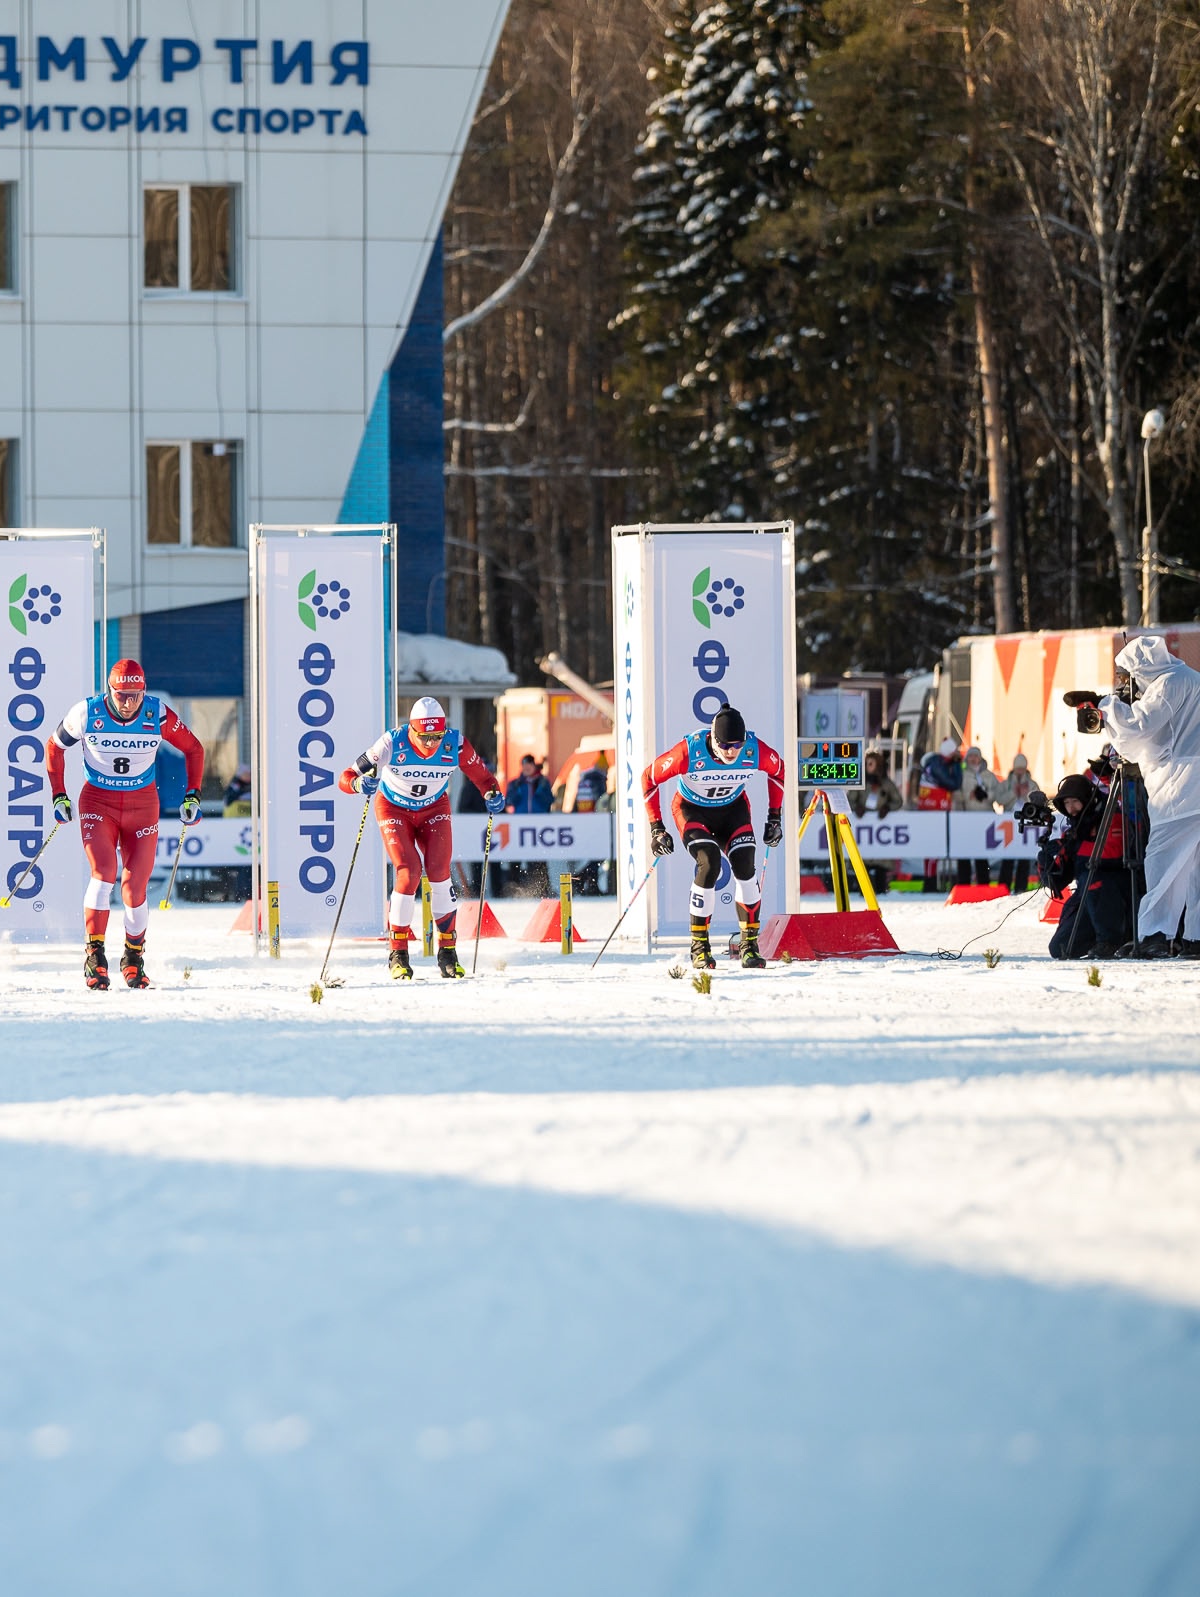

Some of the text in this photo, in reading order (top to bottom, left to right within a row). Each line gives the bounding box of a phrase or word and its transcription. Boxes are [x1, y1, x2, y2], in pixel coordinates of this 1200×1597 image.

[211, 107, 368, 136] СПОРТА
[115, 675, 145, 684] LUKOIL
[101, 739, 158, 749] ФОСАГРО
[6, 646, 46, 900] ФОСАГРО
[113, 757, 131, 775] 8
[298, 642, 336, 894] ФОСАГРО
[625, 641, 636, 891] ФОСАГРО
[802, 763, 857, 779] 14:34.19
[410, 784, 428, 798] 9
[705, 786, 733, 798] 15
[519, 827, 575, 847] ПСБ
[856, 825, 911, 845] ПСБ
[271, 897, 279, 908] 2
